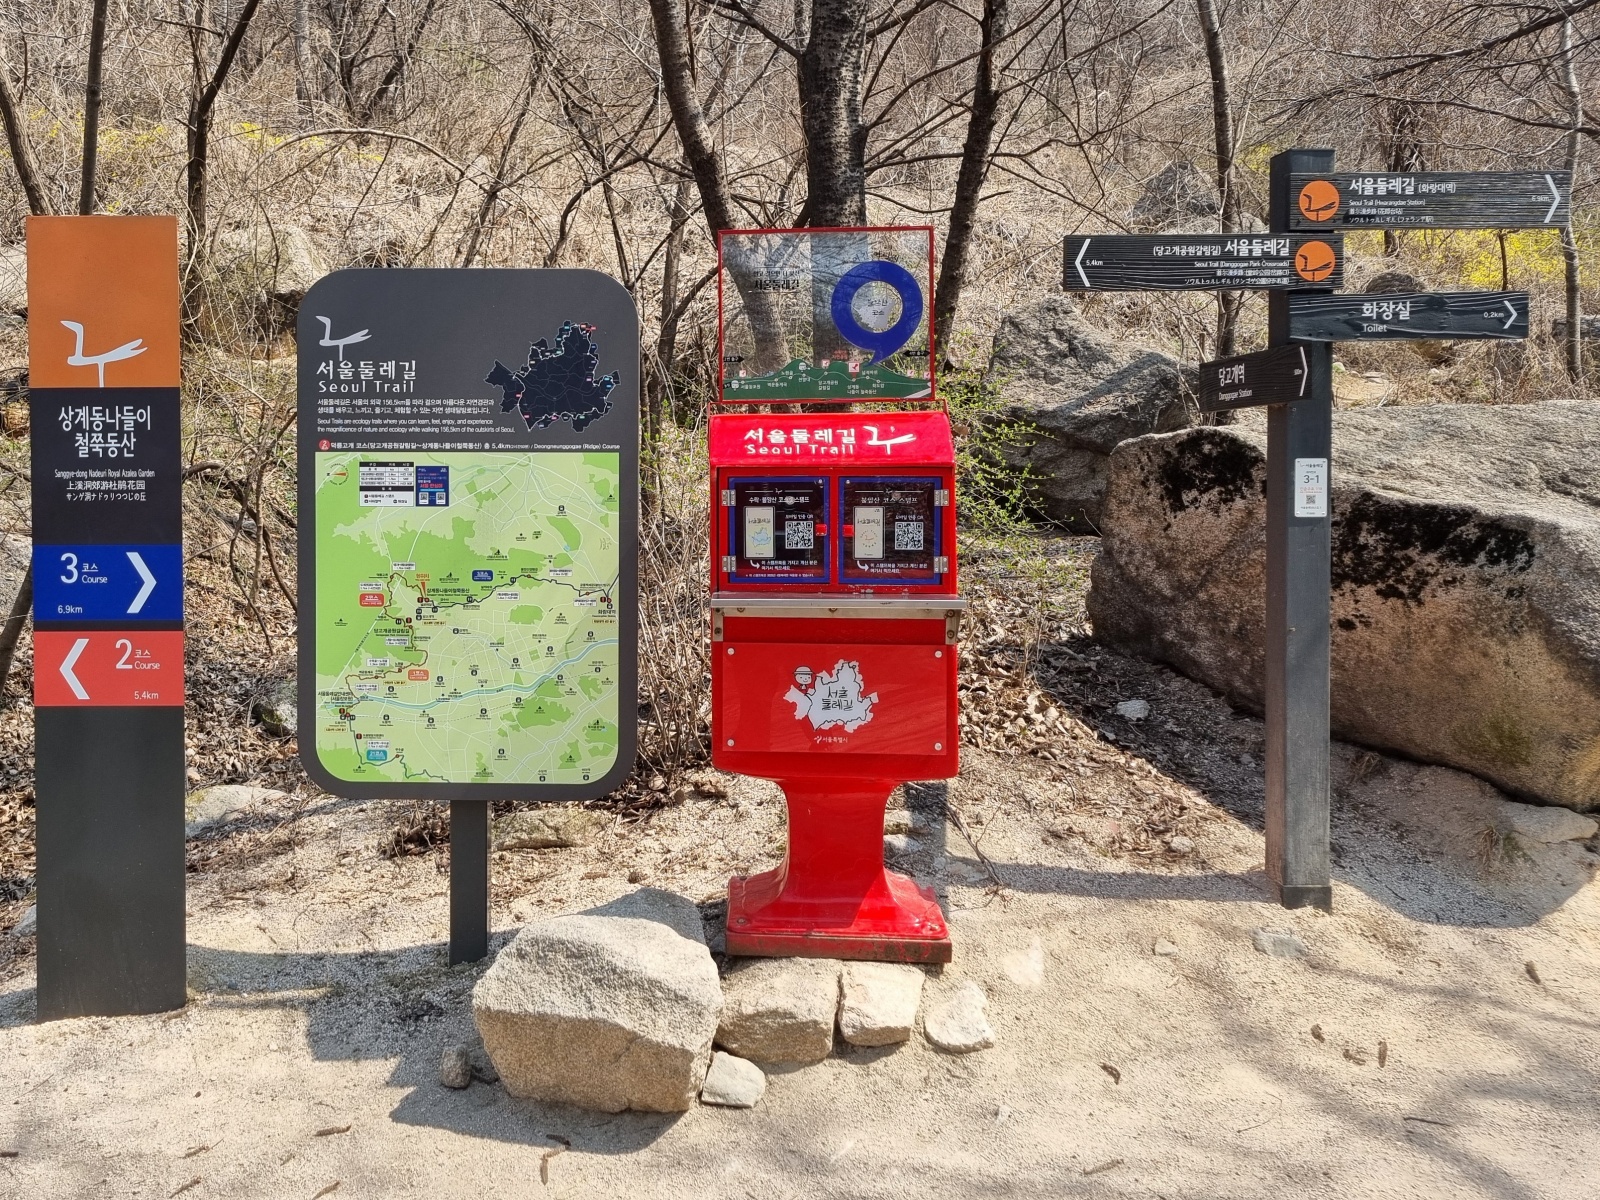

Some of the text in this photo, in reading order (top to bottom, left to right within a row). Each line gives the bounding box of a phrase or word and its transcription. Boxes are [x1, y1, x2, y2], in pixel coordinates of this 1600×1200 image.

[1349, 176, 1456, 195] 서울둘레길 (화랑대역)
[1153, 238, 1290, 257] (당고개공원갈림길) 서울둘레길
[754, 279, 800, 291] 서울둘레길
[1361, 301, 1411, 321] 화장실
[1362, 323, 1388, 333] Toilet
[316, 360, 417, 380] 서울둘레길
[1218, 363, 1245, 387] 당고개역
[318, 380, 414, 393] Seoul Trail
[1238, 388, 1253, 398] Station
[58, 405, 151, 432] 상계동나들이
[744, 428, 856, 444] 서울둘레길
[74, 432, 137, 458] 철쭉동산
[745, 444, 855, 455] Seoul Trail
[54, 469, 88, 478] Sanggye-dong
[107, 469, 120, 478] Royal
[122, 469, 137, 478] Azalea
[138, 469, 156, 478] Garden
[1303, 474, 1320, 484] 3-1
[60, 553, 79, 584] 3
[82, 575, 108, 584] Course
[57, 605, 83, 614] 6.9km
[115, 639, 133, 669] 2
[134, 661, 161, 670] Course
[134, 691, 159, 700] 5.4km
[827, 686, 849, 699] 서울
[821, 698, 854, 711] 둘레길
